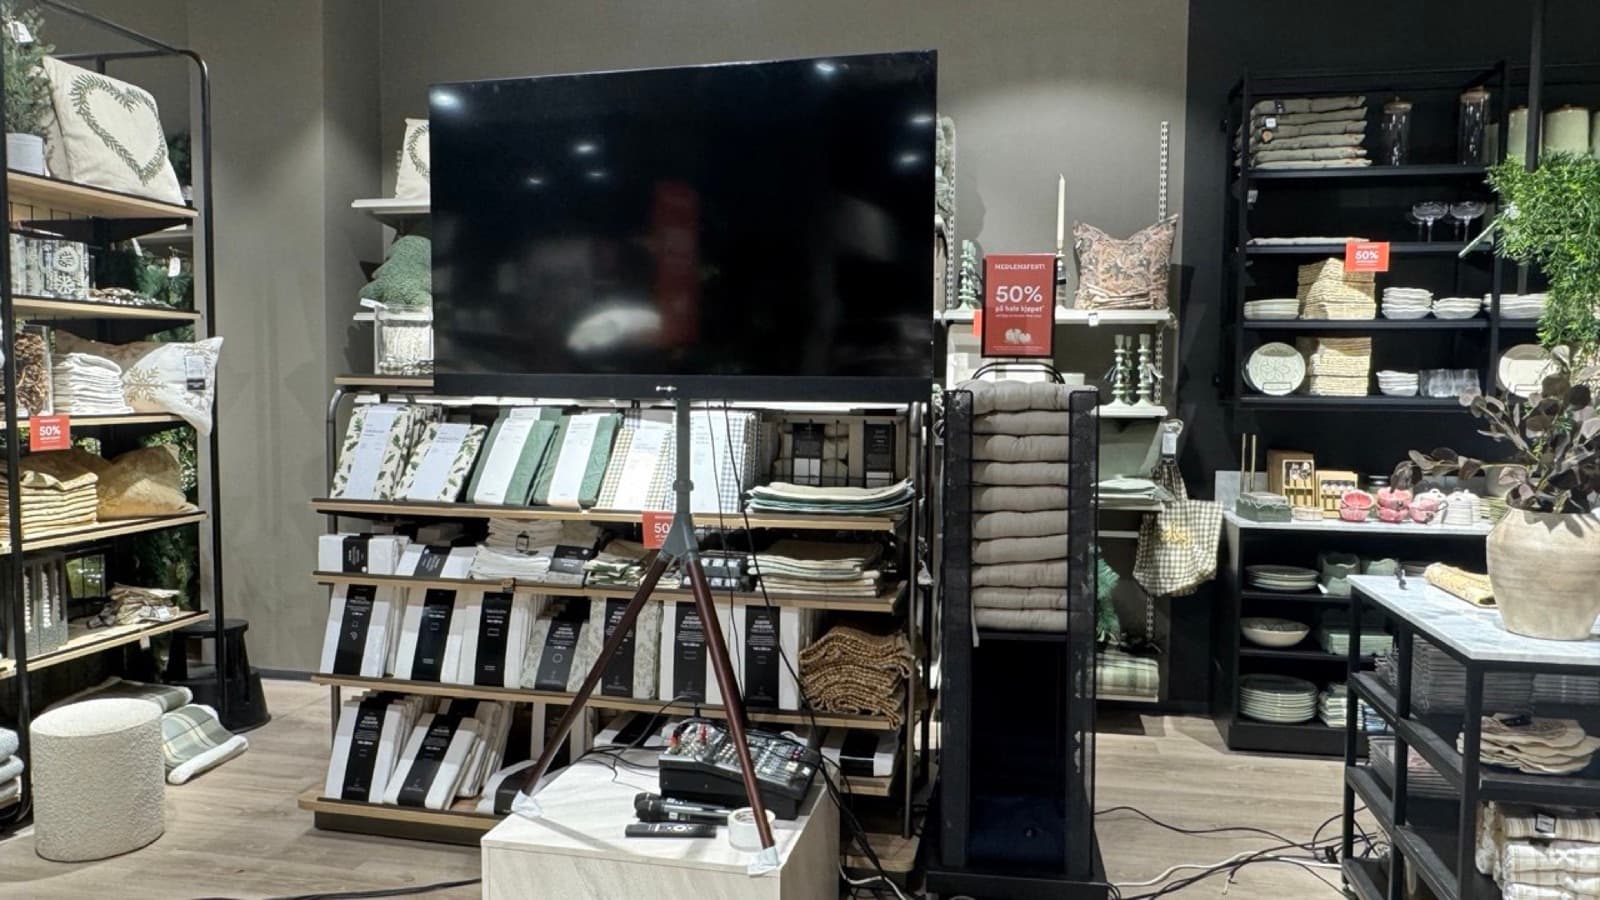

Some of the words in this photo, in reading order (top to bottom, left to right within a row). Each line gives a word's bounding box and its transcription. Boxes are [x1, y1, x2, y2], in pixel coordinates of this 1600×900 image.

[1355, 250, 1379, 260] 50%
[995, 285, 1043, 303] 50%
[39, 425, 61, 436] 50%
[654, 522, 671, 534] 50
